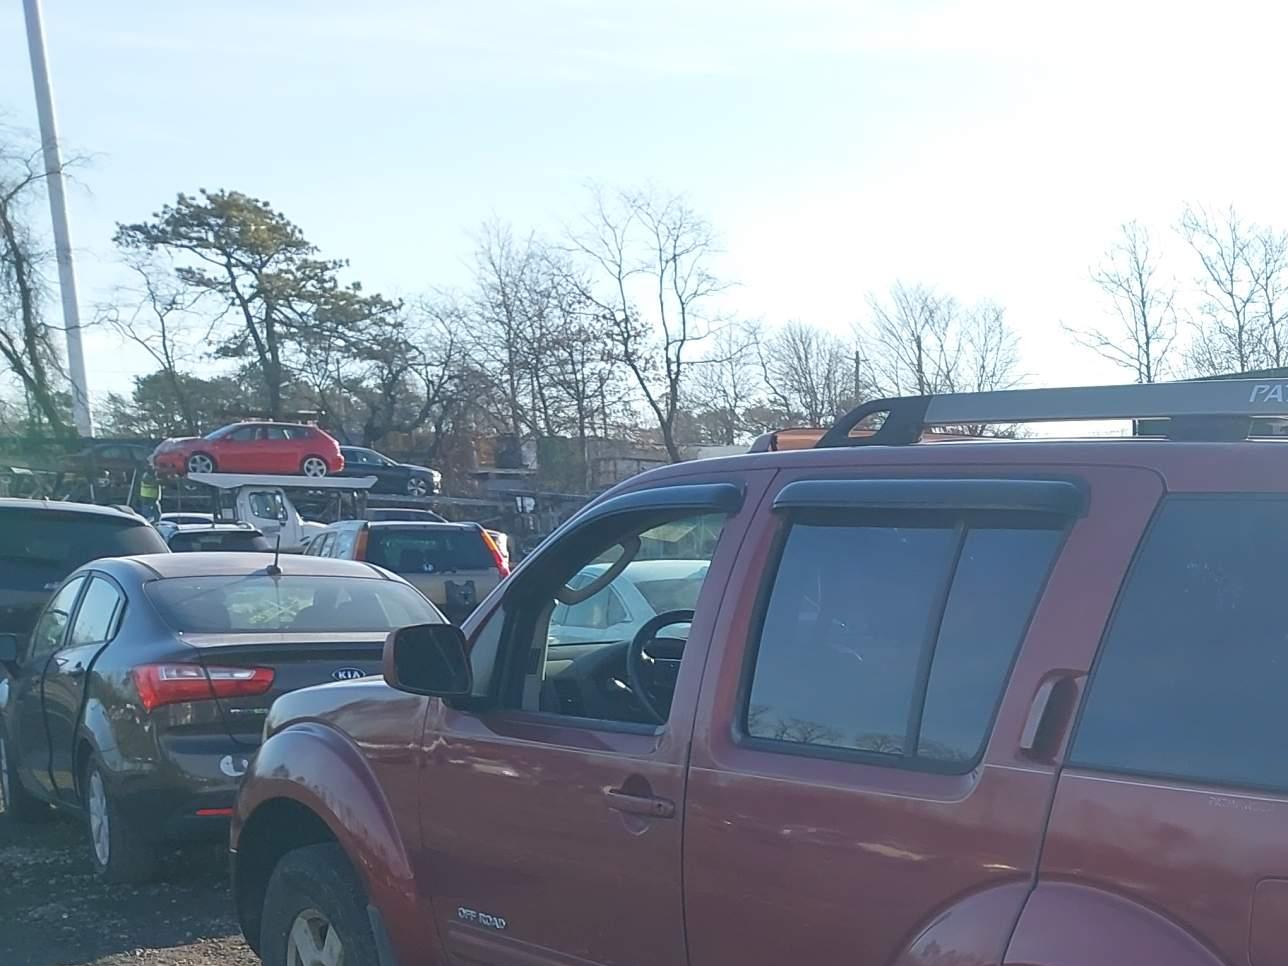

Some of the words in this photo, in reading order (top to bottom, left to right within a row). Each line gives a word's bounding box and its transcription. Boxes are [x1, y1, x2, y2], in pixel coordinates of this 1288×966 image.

[338, 670, 360, 679] KIA
[458, 907, 477, 920] OFF
[479, 912, 506, 929] ROAD
